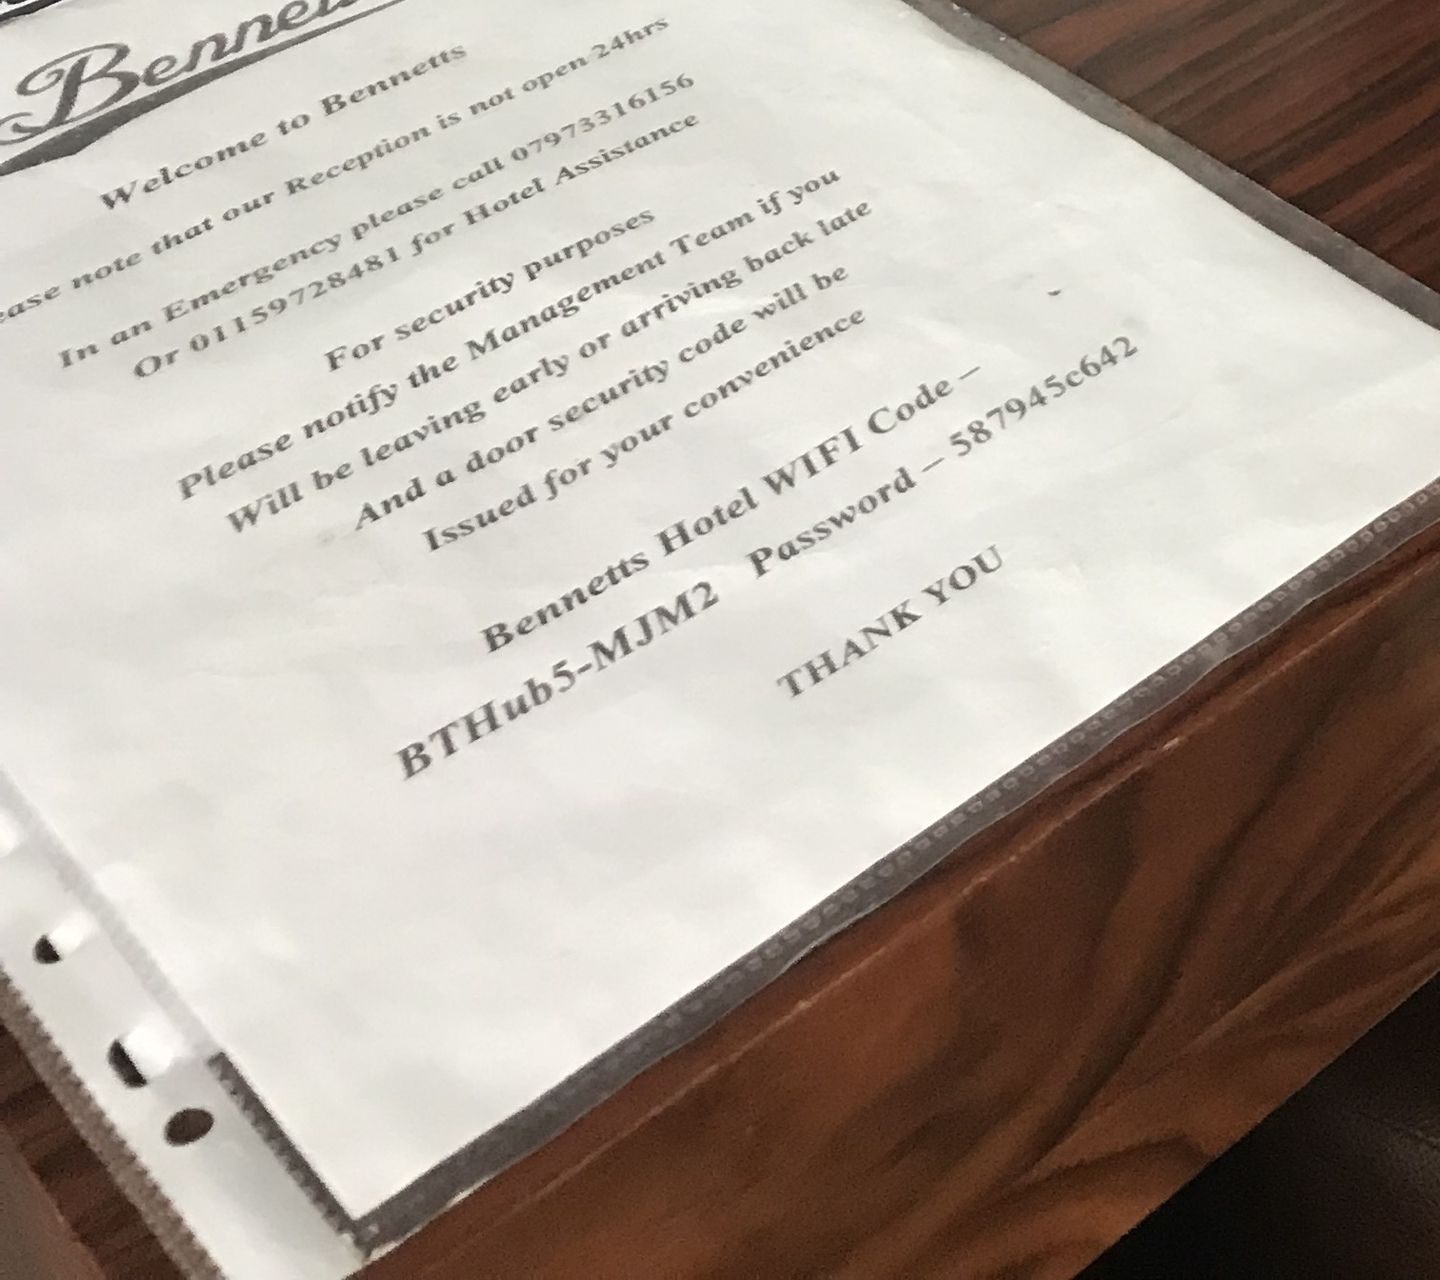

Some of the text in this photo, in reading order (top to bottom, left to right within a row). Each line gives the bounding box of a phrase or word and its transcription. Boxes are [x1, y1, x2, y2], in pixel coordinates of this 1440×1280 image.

[58, 72, 696, 369] In an Emergency please call 07973316156
[71, 251, 144, 290] note
[151, 215, 214, 255] that
[222, 190, 276, 222] our
[284, 125, 432, 196] Reception
[436, 111, 463, 130] is
[468, 85, 516, 117] not
[521, 55, 589, 93] open
[591, 17, 670, 60] 24hrs
[99, 44, 467, 210] Welcome to Bennetts
[133, 113, 700, 380] Or 01159728481 for Hotel Assistance
[177, 168, 842, 502] Please notify the Management Team if you
[226, 199, 873, 534] Will be leaving early or arriving back late
[324, 209, 656, 374] For security purposes
[354, 264, 850, 532] And a door security code will be
[394, 579, 722, 782] BTHub5-MJM2
[746, 465, 918, 580] Password
[948, 335, 1139, 458] 587945c642
[421, 308, 867, 553] Issued for your convenience
[479, 549, 651, 655] Bennetts
[653, 485, 760, 558] Hotel
[760, 425, 865, 497] WIFI
[866, 377, 955, 436] Code
[775, 543, 1005, 700] THANK YOU
